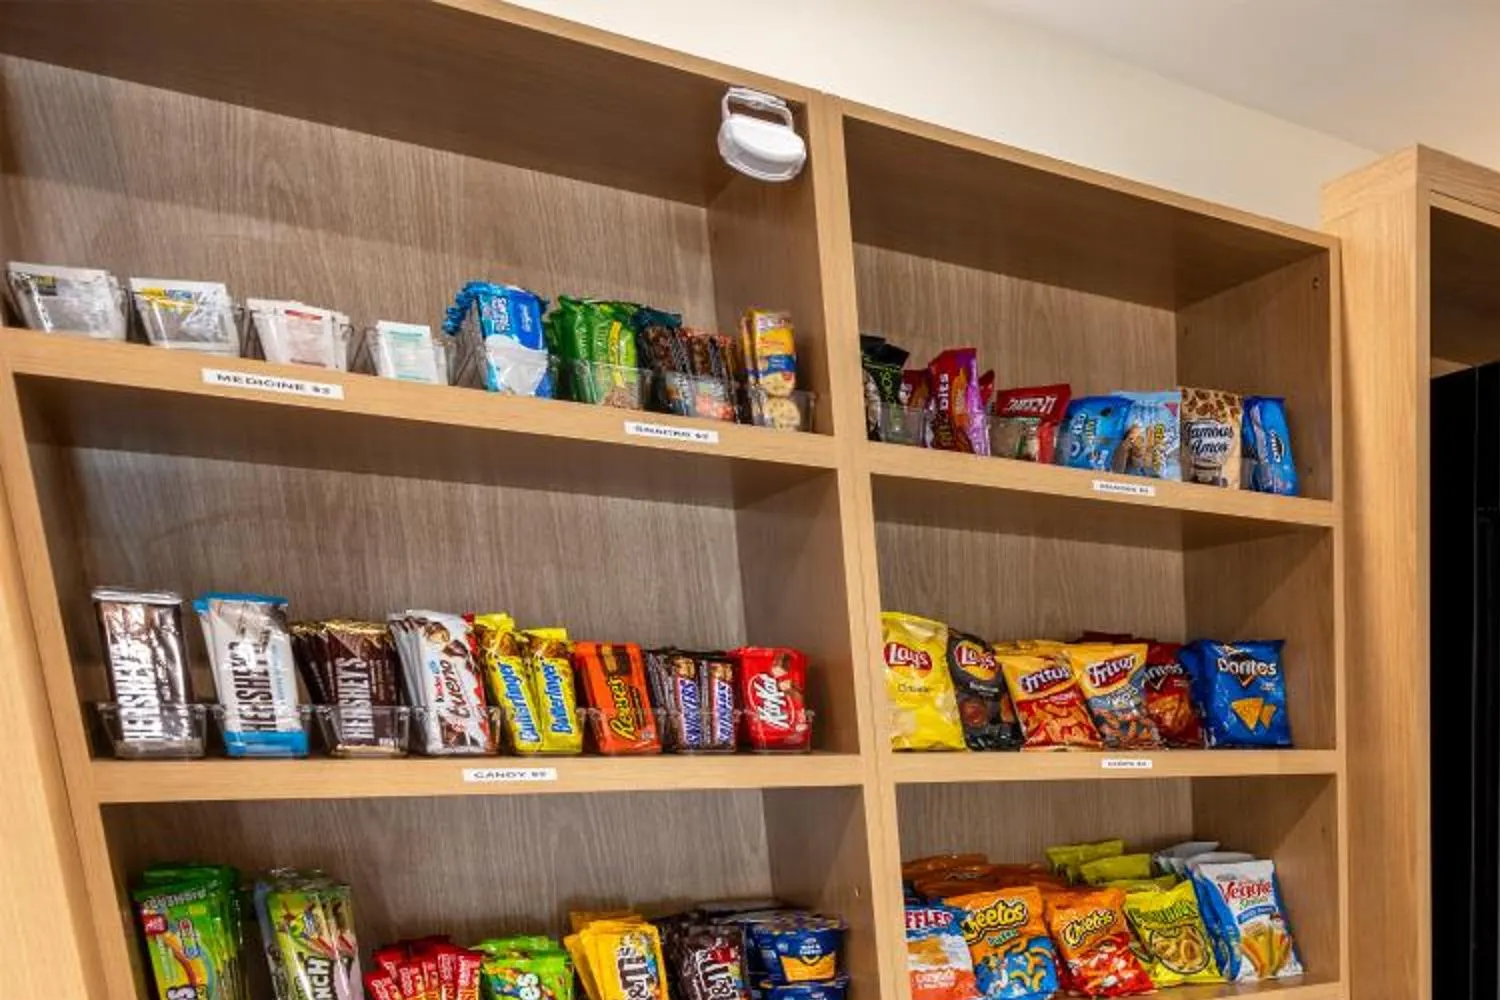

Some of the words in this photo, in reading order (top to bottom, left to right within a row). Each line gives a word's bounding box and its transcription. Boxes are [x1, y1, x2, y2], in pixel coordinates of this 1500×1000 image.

[216, 373, 306, 391] MEDICINE
[1185, 421, 1234, 439] Famous
[1088, 655, 1136, 688] Fritos
[1216, 657, 1277, 675] Doritos
[336, 656, 375, 739] HERSHEY'S
[499, 660, 542, 743] Butterfinger
[542, 662, 573, 735] Butterfinger
[473, 771, 527, 779] CANDY
[1064, 910, 1113, 945] Cheetos
